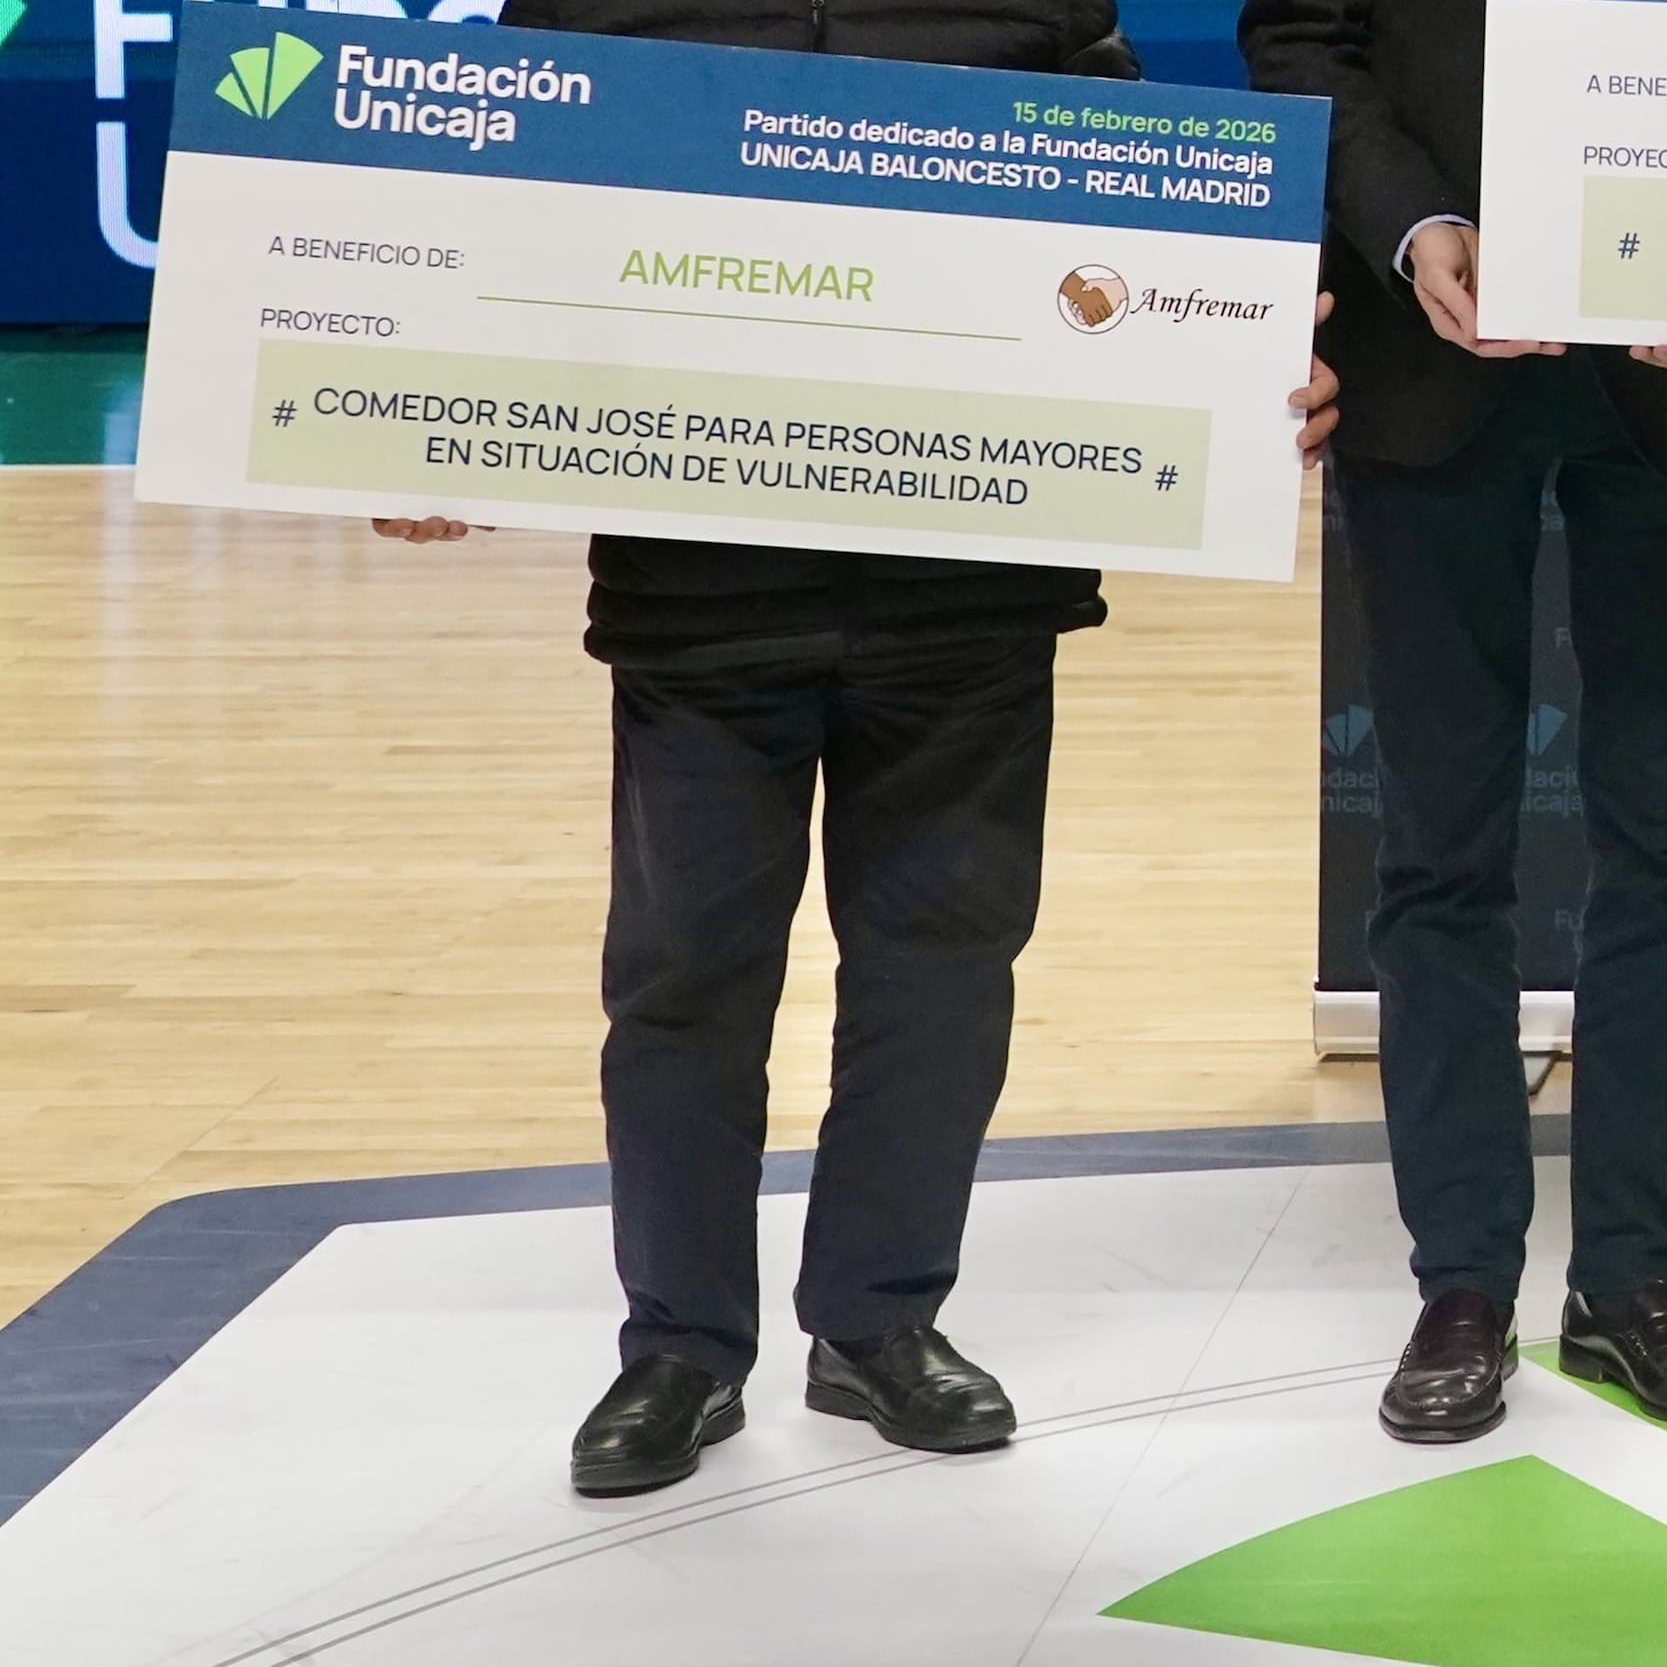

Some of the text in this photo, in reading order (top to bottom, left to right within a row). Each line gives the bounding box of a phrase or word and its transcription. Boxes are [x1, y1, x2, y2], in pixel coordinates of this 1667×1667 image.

[338, 44, 591, 104] Fundación
[1587, 75, 1601, 93] A
[334, 88, 516, 151] Unicaja
[744, 109, 1272, 179] Partido dedicado a la Fundación Unicaja
[1013, 102, 1276, 143] 15 de febrero de 2026
[741, 142, 1270, 206] UNICAJA BALONCESTO REAL MADRID
[268, 236, 464, 269] A BENEFICIO DE:
[619, 249, 873, 301] AMFREMAR
[260, 308, 400, 337] PROYECTO:
[1130, 288, 1273, 323] Amfremar
[314, 388, 1141, 473] COMEDOR SAN JOSÉ PARA PERSONAS MAYORES
[426, 436, 1027, 505] EN SITUACIÓN DE VULNERABILIDAD
